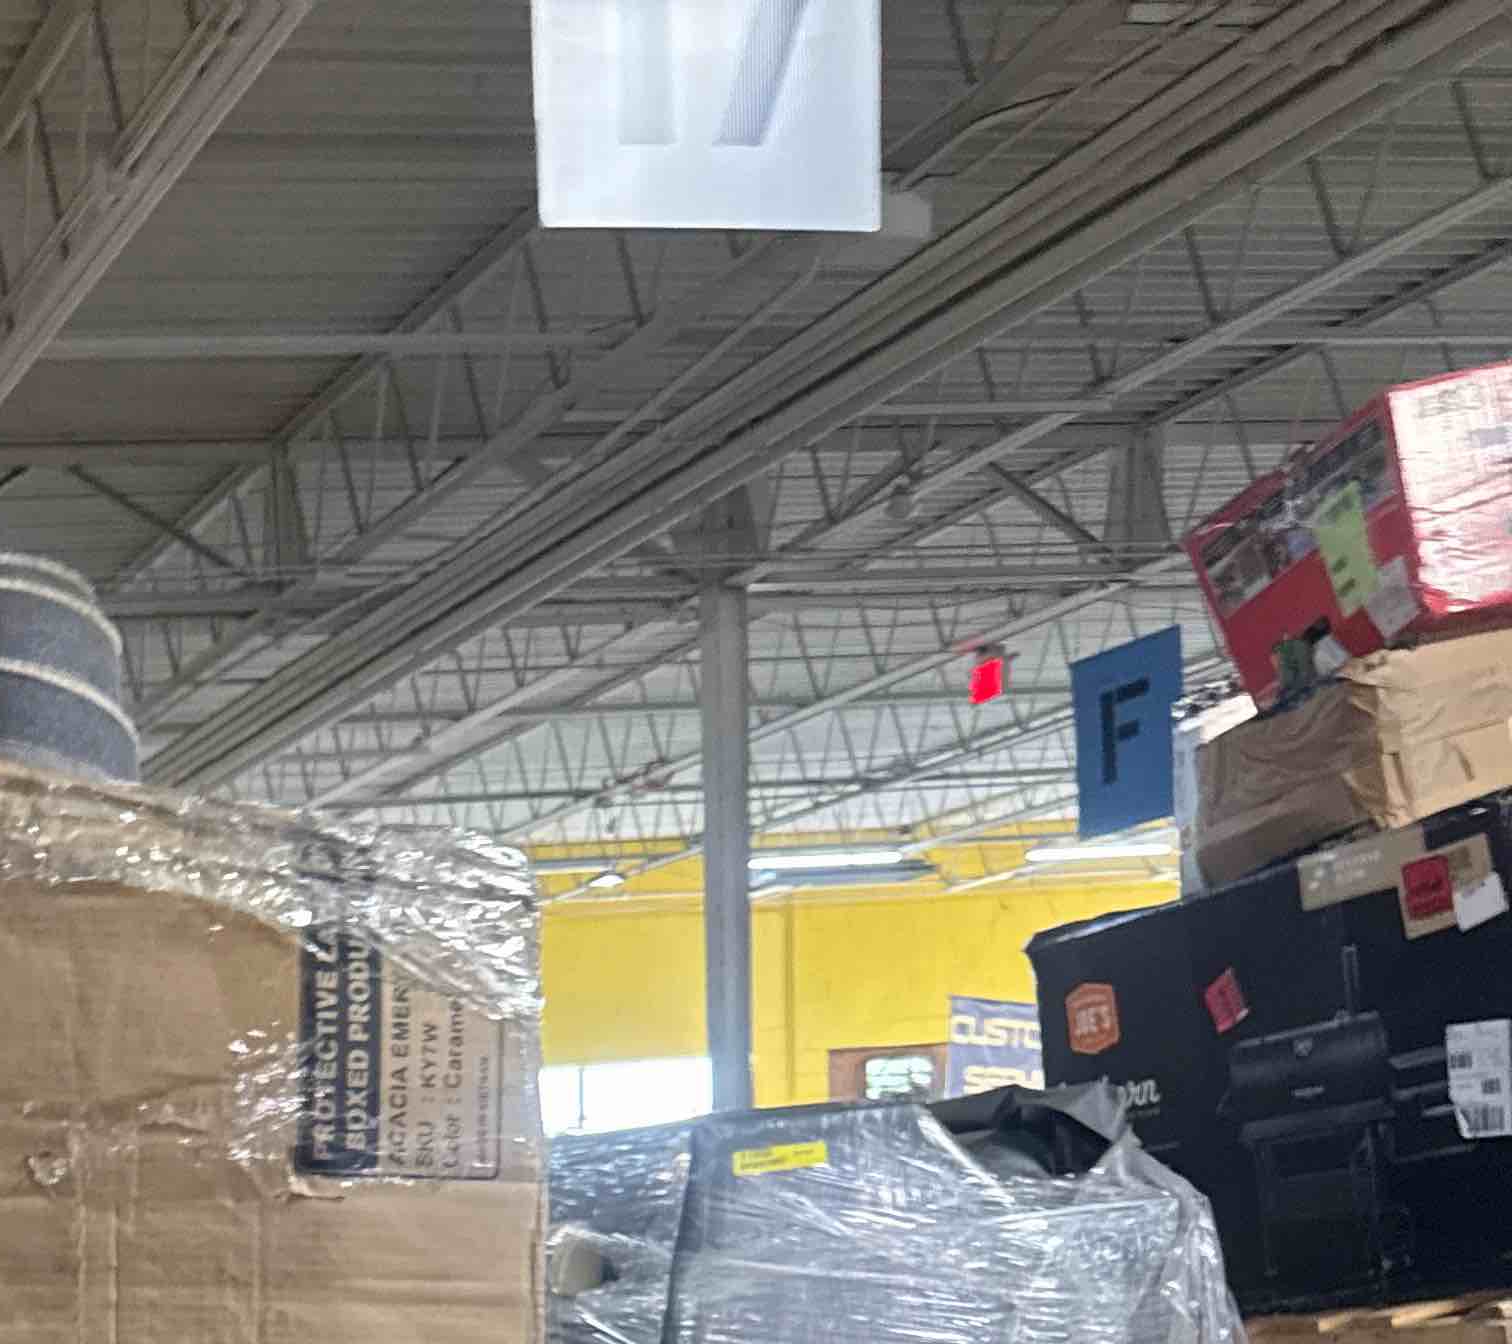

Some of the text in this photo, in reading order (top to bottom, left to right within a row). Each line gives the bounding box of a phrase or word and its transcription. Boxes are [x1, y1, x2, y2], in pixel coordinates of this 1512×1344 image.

[1100, 677, 1151, 786] F
[344, 935, 370, 1044] PRODU
[313, 972, 340, 1160] PROTECTIVE
[344, 1049, 370, 1152] BOXED
[421, 1023, 439, 1088] KY7W
[389, 1066, 409, 1166] ACACIA
[415, 1120, 435, 1168] SKU
